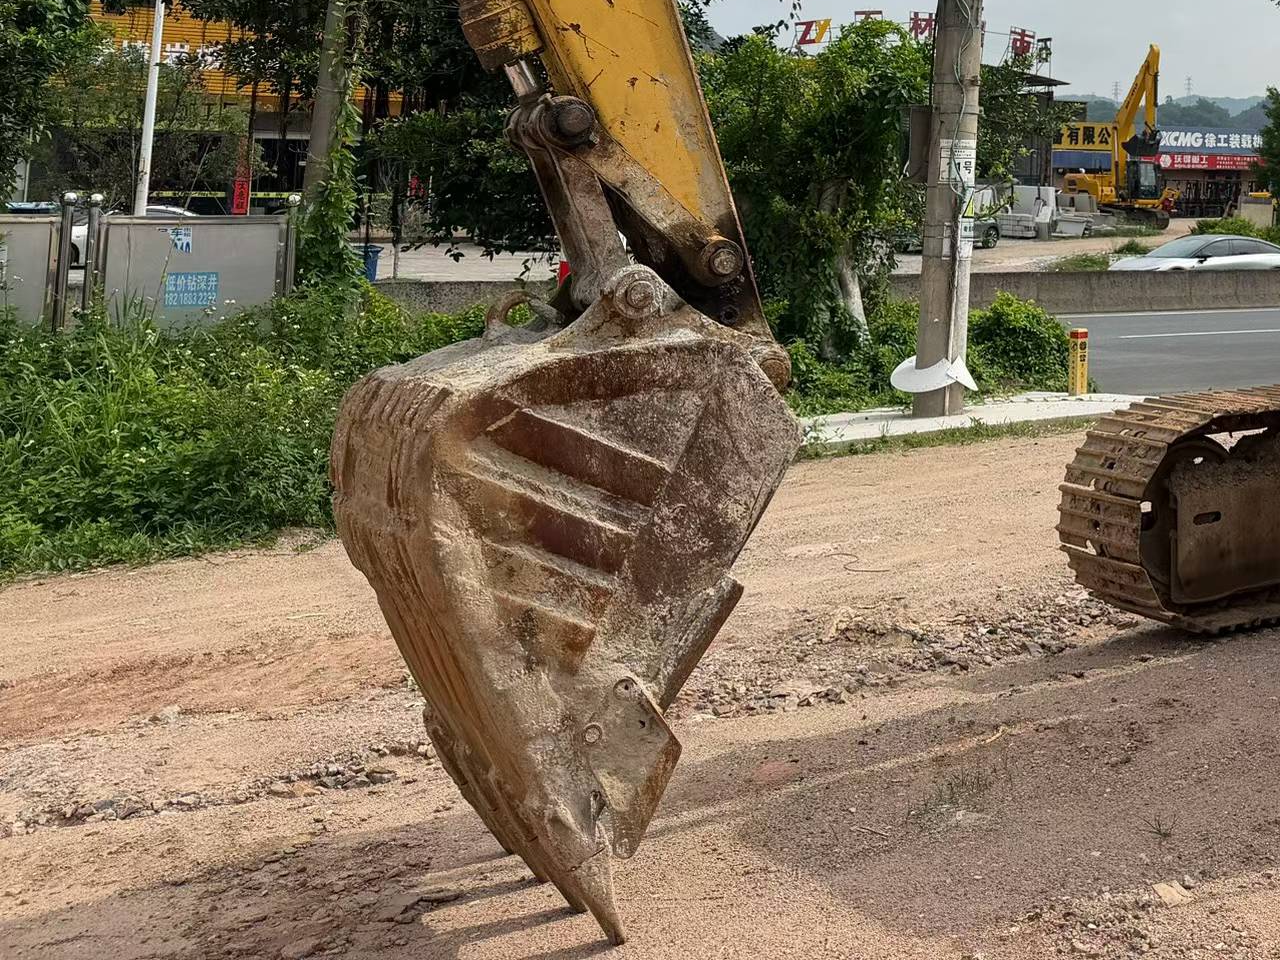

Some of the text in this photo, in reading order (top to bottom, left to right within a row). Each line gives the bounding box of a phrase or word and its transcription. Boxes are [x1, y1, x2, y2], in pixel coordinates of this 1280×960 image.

[1160, 131, 1203, 147] XCMG
[166, 274, 217, 291] 低价钻深井
